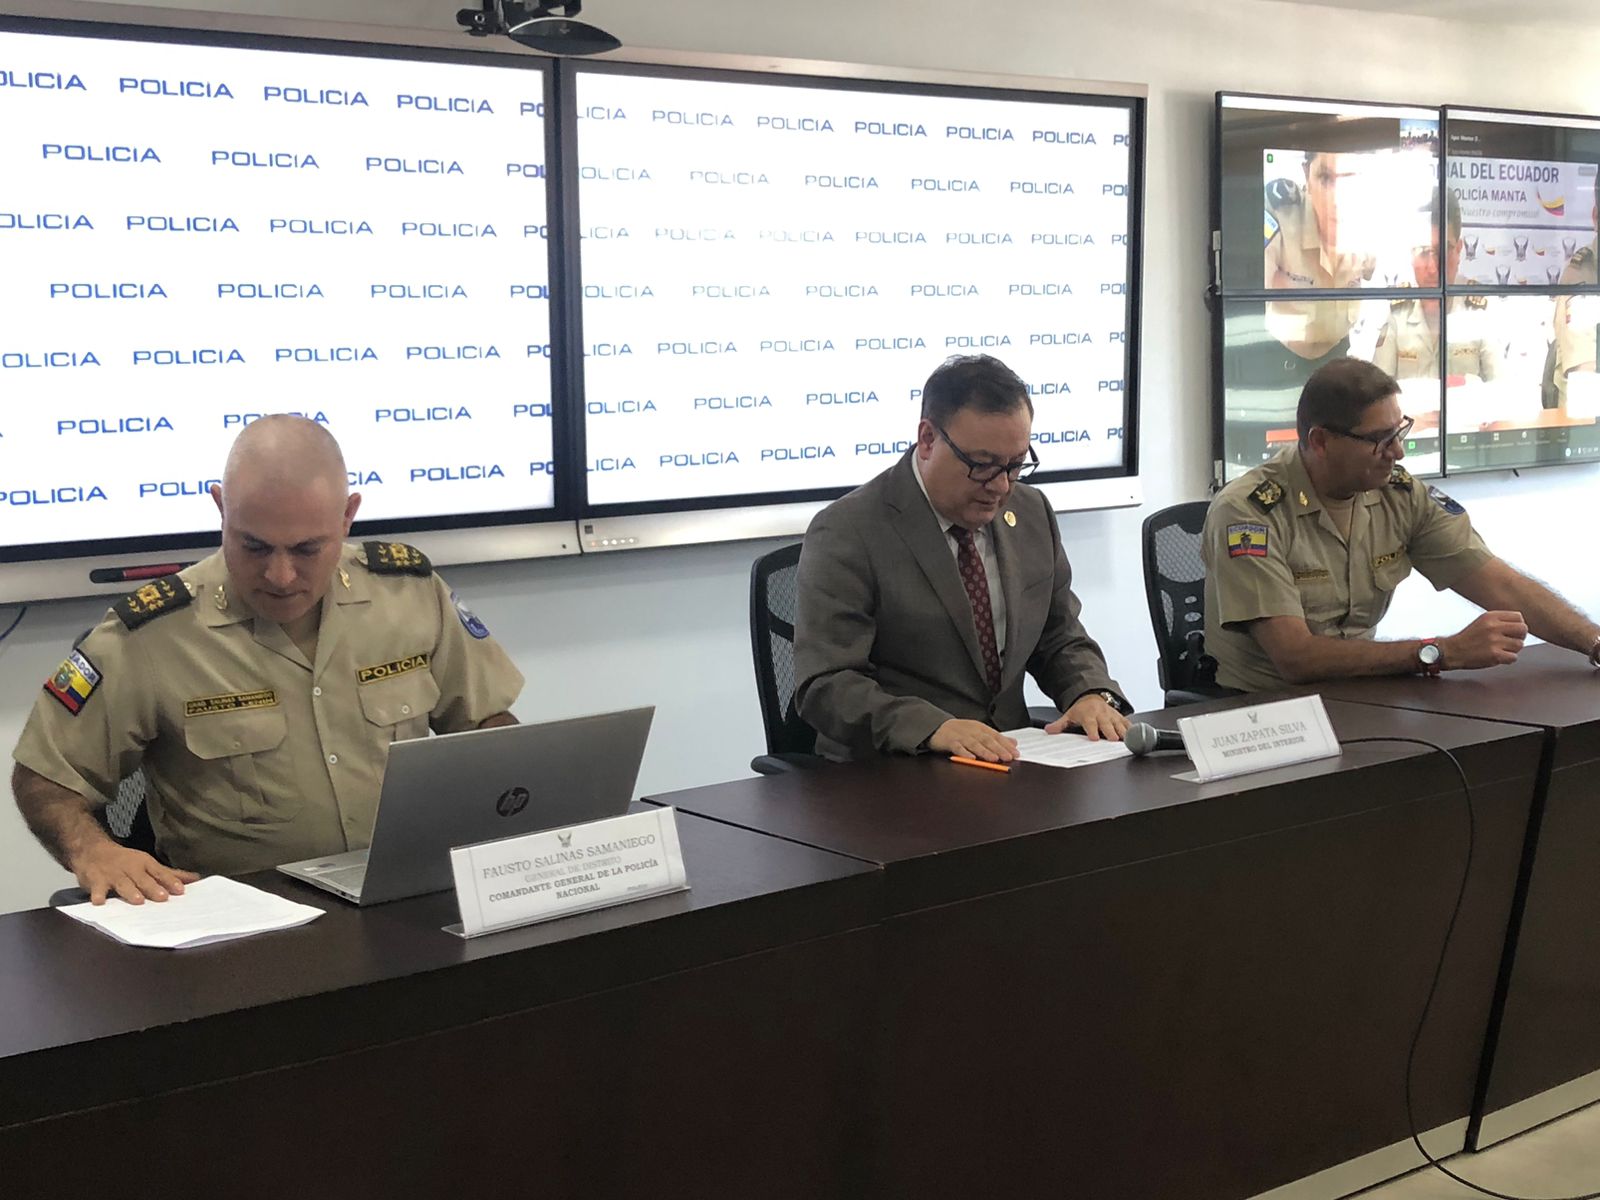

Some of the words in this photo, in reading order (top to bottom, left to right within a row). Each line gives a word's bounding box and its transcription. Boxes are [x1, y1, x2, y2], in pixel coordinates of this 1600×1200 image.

[119, 77, 234, 99] POLICIA
[264, 86, 369, 107] POLICIA
[397, 94, 494, 114] POLICIA
[652, 110, 734, 126] POLICIA
[757, 116, 834, 132] POLICIA
[855, 121, 927, 137] POLICIA
[946, 126, 1014, 141] POLICIA
[1032, 130, 1096, 145] POLICIA
[42, 144, 161, 163] POLICIA
[211, 150, 320, 169] POLICIA
[366, 157, 464, 175] POLICIA
[690, 171, 768, 184] POLICIA
[805, 175, 879, 189] POLICIA
[911, 178, 980, 192] POLICIA
[1010, 182, 1074, 194] POLICIA
[1471, 163, 1495, 180] DEL
[1499, 164, 1559, 183] ECUADOR
[1491, 190, 1527, 202] MANTA
[126, 216, 240, 232] POLICIA
[270, 219, 373, 235] POLICIA
[402, 222, 497, 237] POLICIA
[856, 232, 927, 243] POLICIA
[946, 233, 1013, 244] POLICIA
[1032, 234, 1095, 245] POLICIA
[50, 282, 168, 299] POLICIA
[217, 283, 324, 298] POLICIA
[371, 284, 468, 298] POLICIA
[693, 286, 770, 297] POLICIA
[806, 285, 878, 297] POLICIA
[911, 285, 979, 296] POLICIA
[1009, 284, 1072, 295] POLICIA
[657, 342, 737, 354] POLICIA
[760, 339, 835, 352] POLICIA
[856, 337, 926, 350] POLICIA
[945, 335, 1012, 347] POLICIA
[1030, 333, 1092, 345] POLICIA
[2, 352, 101, 368] OLICIA
[133, 349, 246, 366] POLICIA
[275, 347, 379, 362] POLICIA
[406, 345, 501, 360] POLICIA
[694, 395, 772, 410] POLICIA
[806, 391, 879, 405] POLICIA
[57, 416, 174, 435] POLICIA
[375, 406, 472, 423] POLICIA
[659, 451, 739, 467] POLICIA
[761, 445, 836, 462] POLICIA
[410, 464, 505, 483] POLICIA
[361, 655, 427, 681] POLICIA
[1212, 734, 1239, 748] JUAN
[1240, 727, 1278, 743] ZAPATA
[1278, 721, 1307, 735] SILVA
[1257, 743, 1272, 751] DEL
[483, 860, 531, 879] FAUSTO
[534, 848, 584, 869] SALINAS
[587, 834, 655, 858] SAMANIEGO
[489, 882, 552, 902] COMANDANTE
[554, 872, 595, 888] GENERAL
[597, 870, 610, 878] DE
[611, 867, 623, 876] LA
[556, 883, 600, 899] NACIONAL
